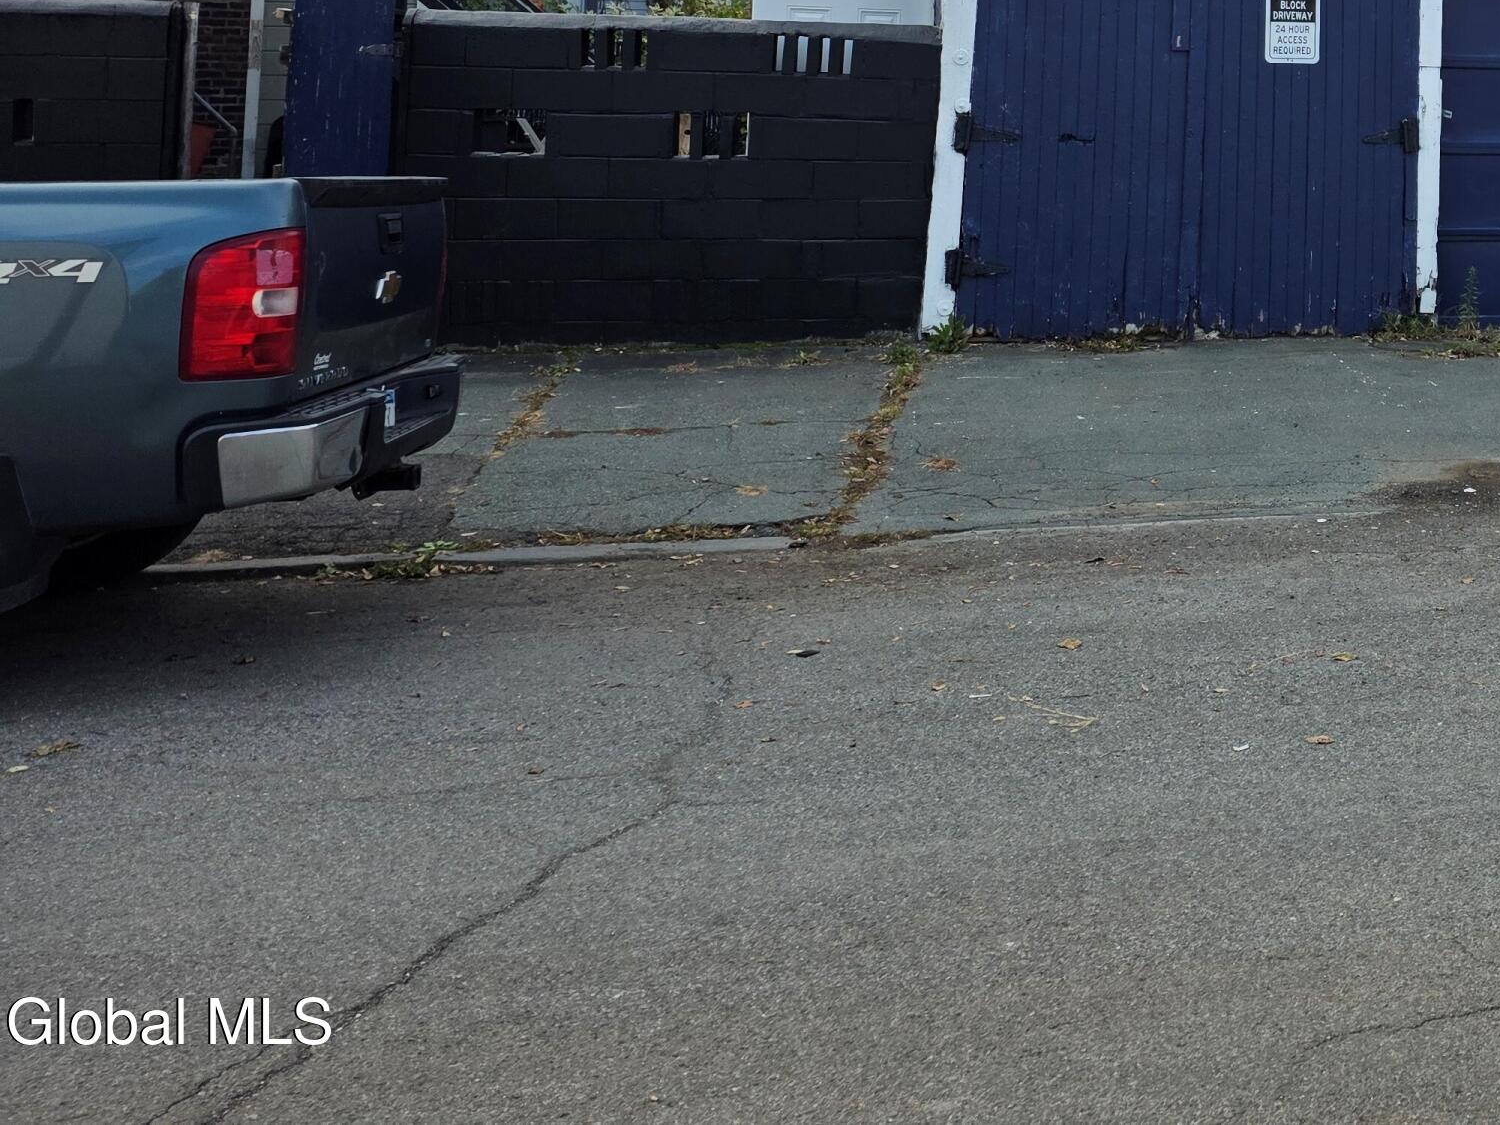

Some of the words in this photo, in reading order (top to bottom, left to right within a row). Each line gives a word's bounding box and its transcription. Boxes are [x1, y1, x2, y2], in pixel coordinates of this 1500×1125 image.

[1280, 0, 1306, 10] BLOCK
[1273, 10, 1313, 20] DRIVEWAY
[1275, 24, 1286, 33] 24
[1288, 25, 1310, 34] HOUR
[1277, 35, 1308, 44] ACCESS
[1273, 46, 1312, 55] REQUIRED
